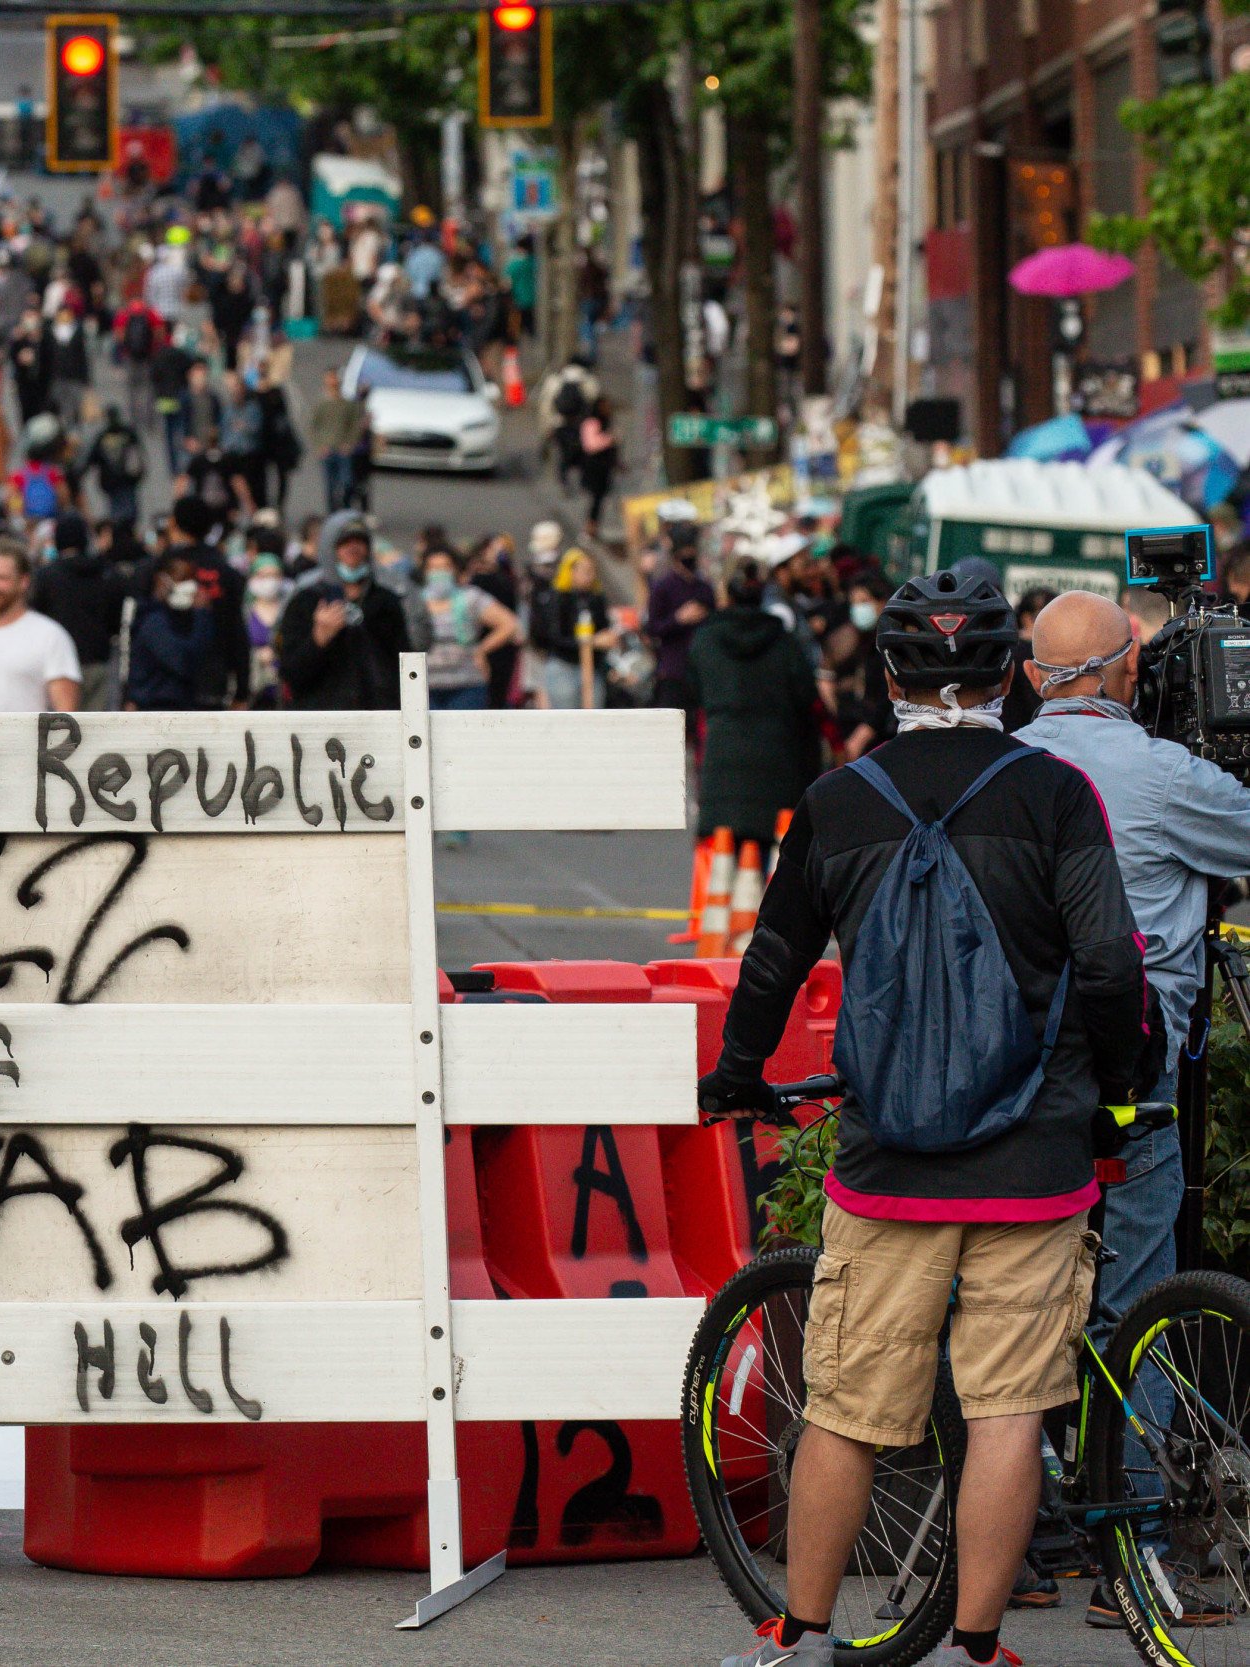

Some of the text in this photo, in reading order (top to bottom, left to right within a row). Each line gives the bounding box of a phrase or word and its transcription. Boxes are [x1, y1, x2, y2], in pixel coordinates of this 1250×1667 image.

[36, 712, 395, 832] Republic
[73, 1309, 263, 1421] Hill
[689, 1366, 702, 1426] cypher
[1113, 1577, 1142, 1634] TERRA
[1140, 1627, 1161, 1658] ALL
